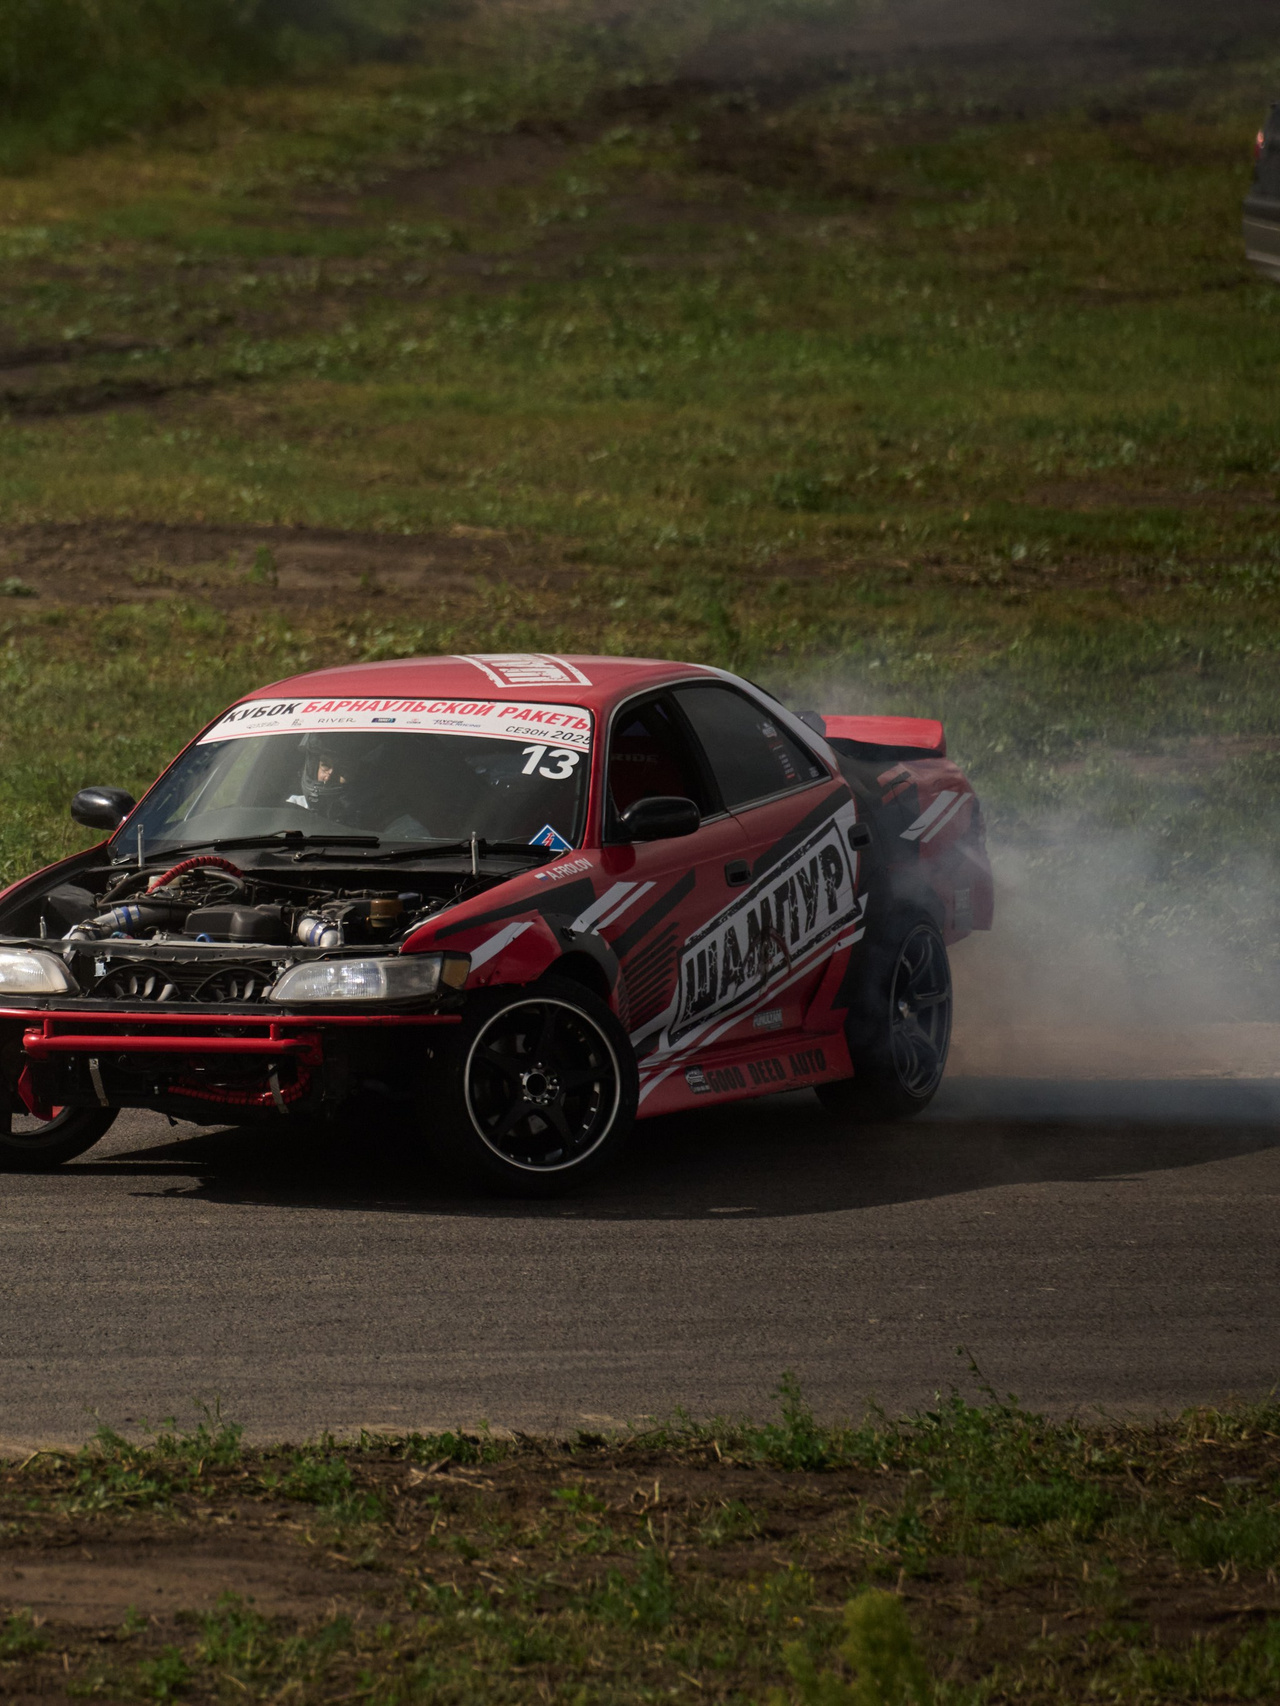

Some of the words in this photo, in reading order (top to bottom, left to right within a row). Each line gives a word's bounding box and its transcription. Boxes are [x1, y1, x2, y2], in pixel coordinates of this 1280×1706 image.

[222, 702, 302, 724] КУБОК
[301, 700, 496, 717] БАРНАУЛЬСКОЙ
[506, 725, 549, 738] СЕЗОН
[549, 730, 590, 745] 2025
[520, 744, 580, 780] 13
[546, 857, 594, 881] A.FROLOV
[684, 843, 844, 1025] ШАМПУР
[707, 1066, 746, 1093] GOOD
[747, 1058, 787, 1085] DEED
[789, 1048, 827, 1077] AUTO
